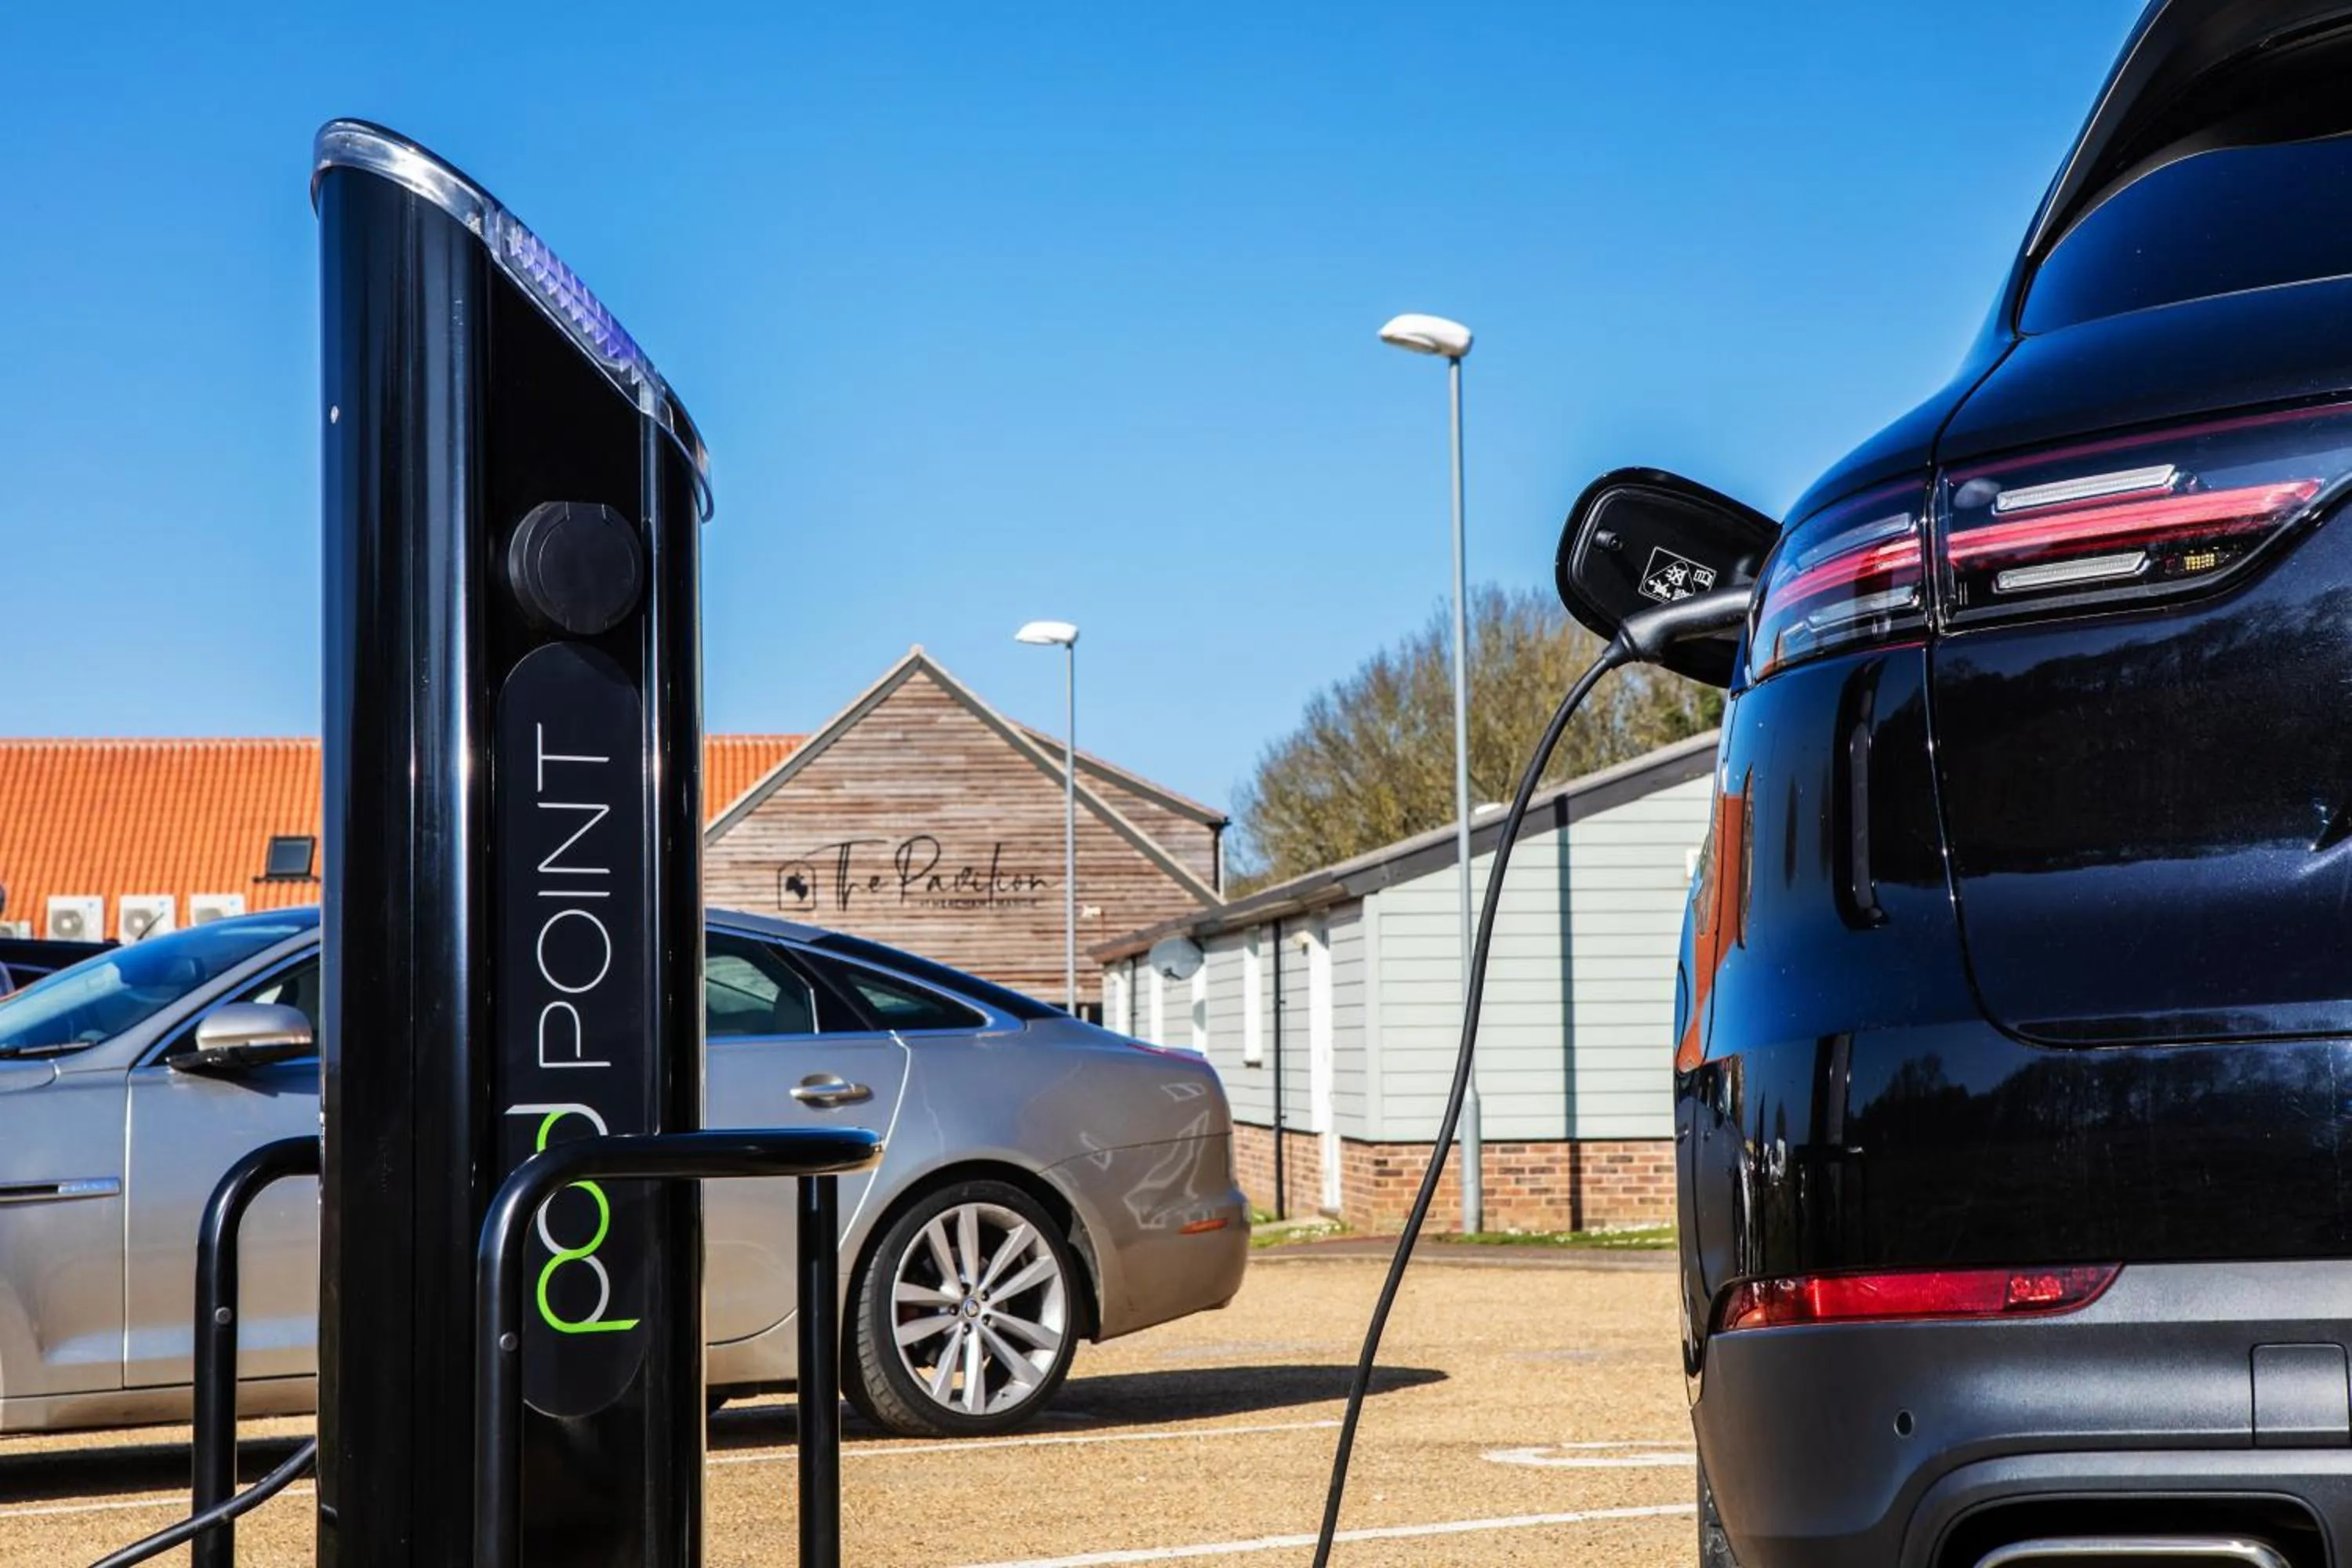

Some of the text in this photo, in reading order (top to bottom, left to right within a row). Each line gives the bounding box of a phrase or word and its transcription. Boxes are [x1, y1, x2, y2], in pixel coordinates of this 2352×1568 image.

[537, 722, 611, 1068] POINT
[802, 835, 1054, 912] The Pavilion
